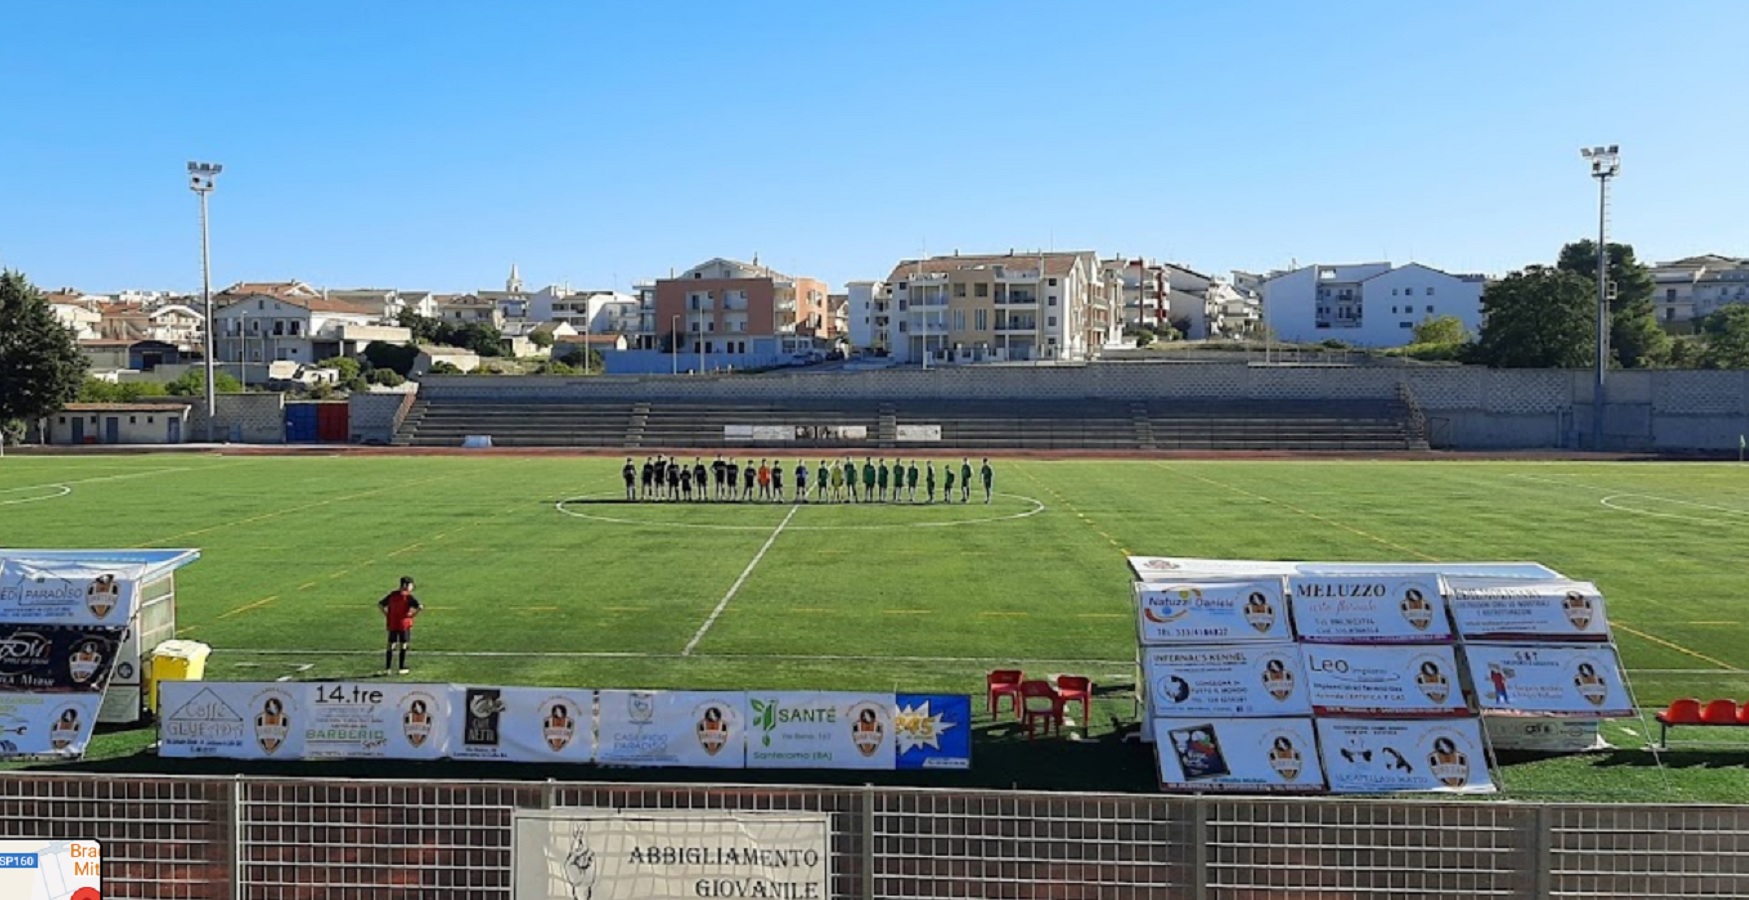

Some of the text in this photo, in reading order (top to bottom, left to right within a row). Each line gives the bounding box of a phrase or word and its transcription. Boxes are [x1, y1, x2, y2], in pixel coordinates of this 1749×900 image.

[25, 586, 82, 600] PARADISO
[1296, 583, 1386, 598] MELUZZO
[1309, 654, 1349, 674] Leo
[315, 684, 384, 704] 14.tre
[779, 705, 837, 723] SANTÉ
[628, 846, 819, 867] ABBIGLIAMENTO
[695, 878, 819, 900] GIOVANILE
